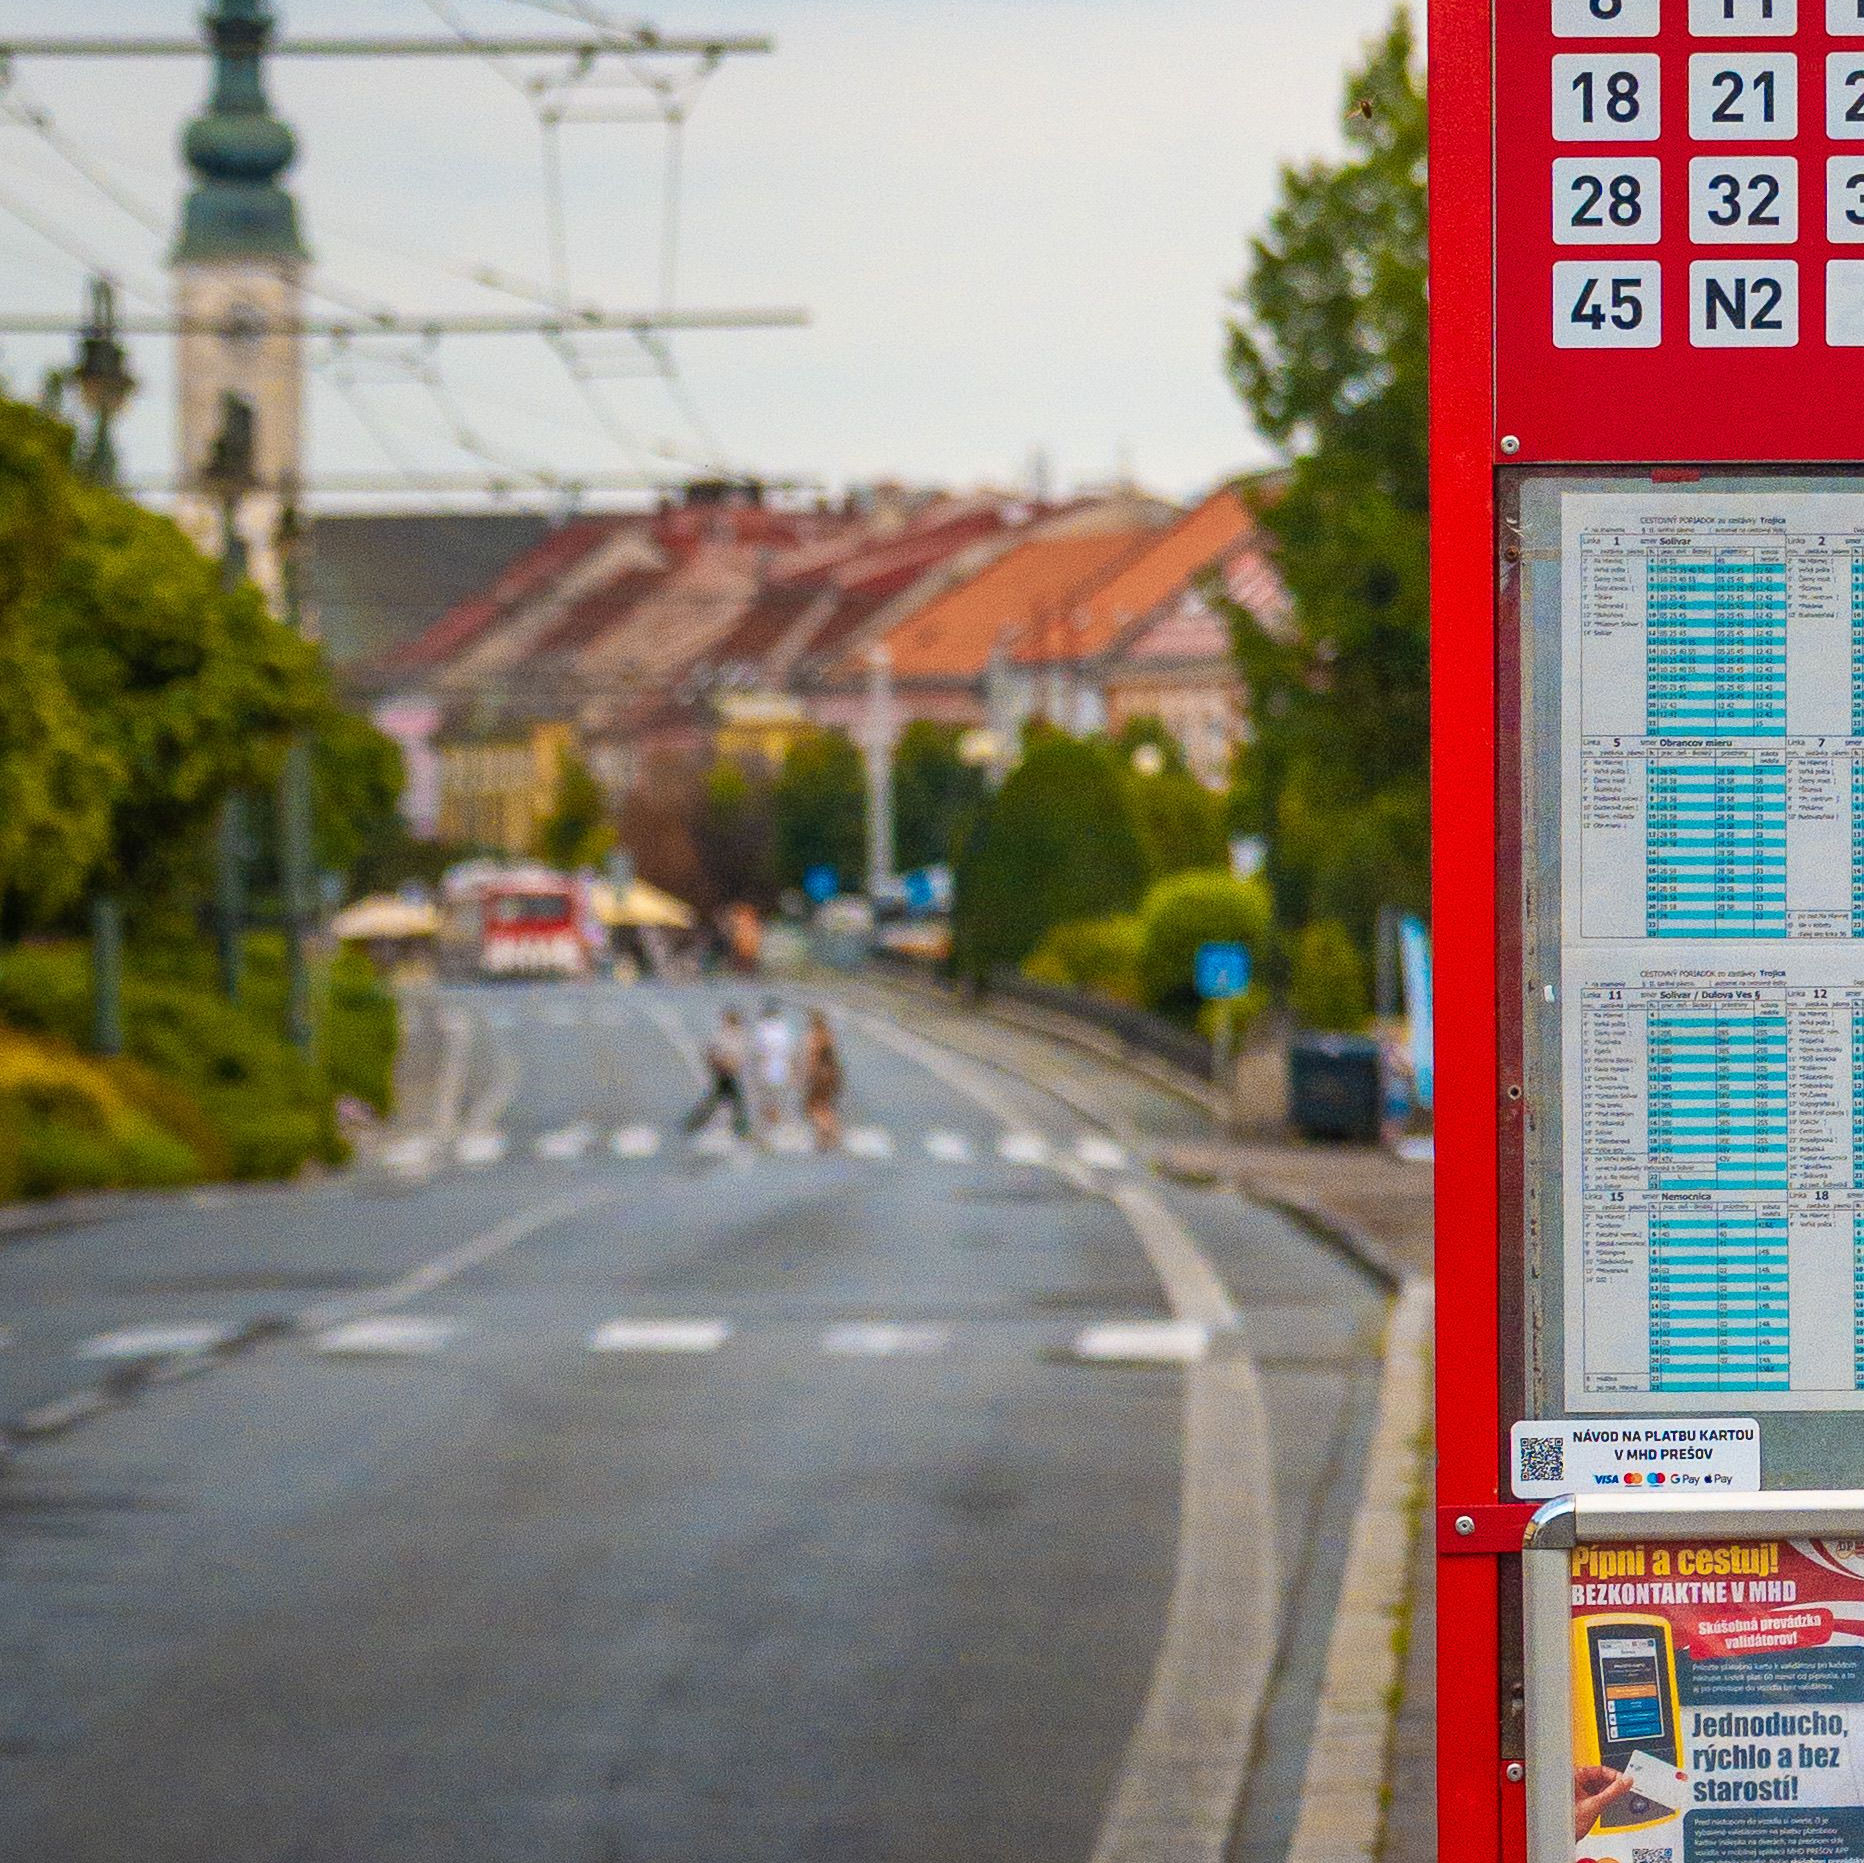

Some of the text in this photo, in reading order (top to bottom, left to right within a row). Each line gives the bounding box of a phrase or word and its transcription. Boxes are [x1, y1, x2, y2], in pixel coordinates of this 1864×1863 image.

[1572, 72, 1639, 123] 18
[1711, 71, 1775, 123] 21
[1570, 176, 1642, 228] 28
[1709, 175, 1780, 226] 32
[1571, 280, 1642, 331] 45
[1706, 278, 1783, 330] N2
[1613, 537, 1691, 545] 1 Solivar
[1818, 536, 1826, 545] 2
[1613, 738, 1732, 747] 5 Obrancov mieru
[1818, 738, 1825, 747] 7
[1609, 991, 1622, 999] 11
[1660, 991, 1690, 999] Solivar
[1814, 990, 1827, 998] 12
[1611, 1192, 1711, 1201] 15 Nemocnica
[1815, 1191, 1829, 1200] 18
[1573, 1429, 1754, 1442] NÁVOD NA PLATBU KARTOU
[1615, 1446, 1713, 1460] V MHD PREŠOV
[1594, 1475, 1619, 1484] VISA
[1682, 1475, 1700, 1485] Pay
[1714, 1474, 1732, 1484] Pay
[1572, 1544, 1779, 1579] Pípni a cestuj!
[1572, 1581, 1796, 1605] BEZKONTAKTNE V MHD
[1699, 1615, 1821, 1635] Skúšobná prevádzka
[1725, 1633, 1797, 1650] validátorov!
[1692, 1711, 1848, 1738] Jednoducho,
[1693, 1744, 1839, 1771] rýchlo a bez
[1693, 1776, 1798, 1801] starostí!
